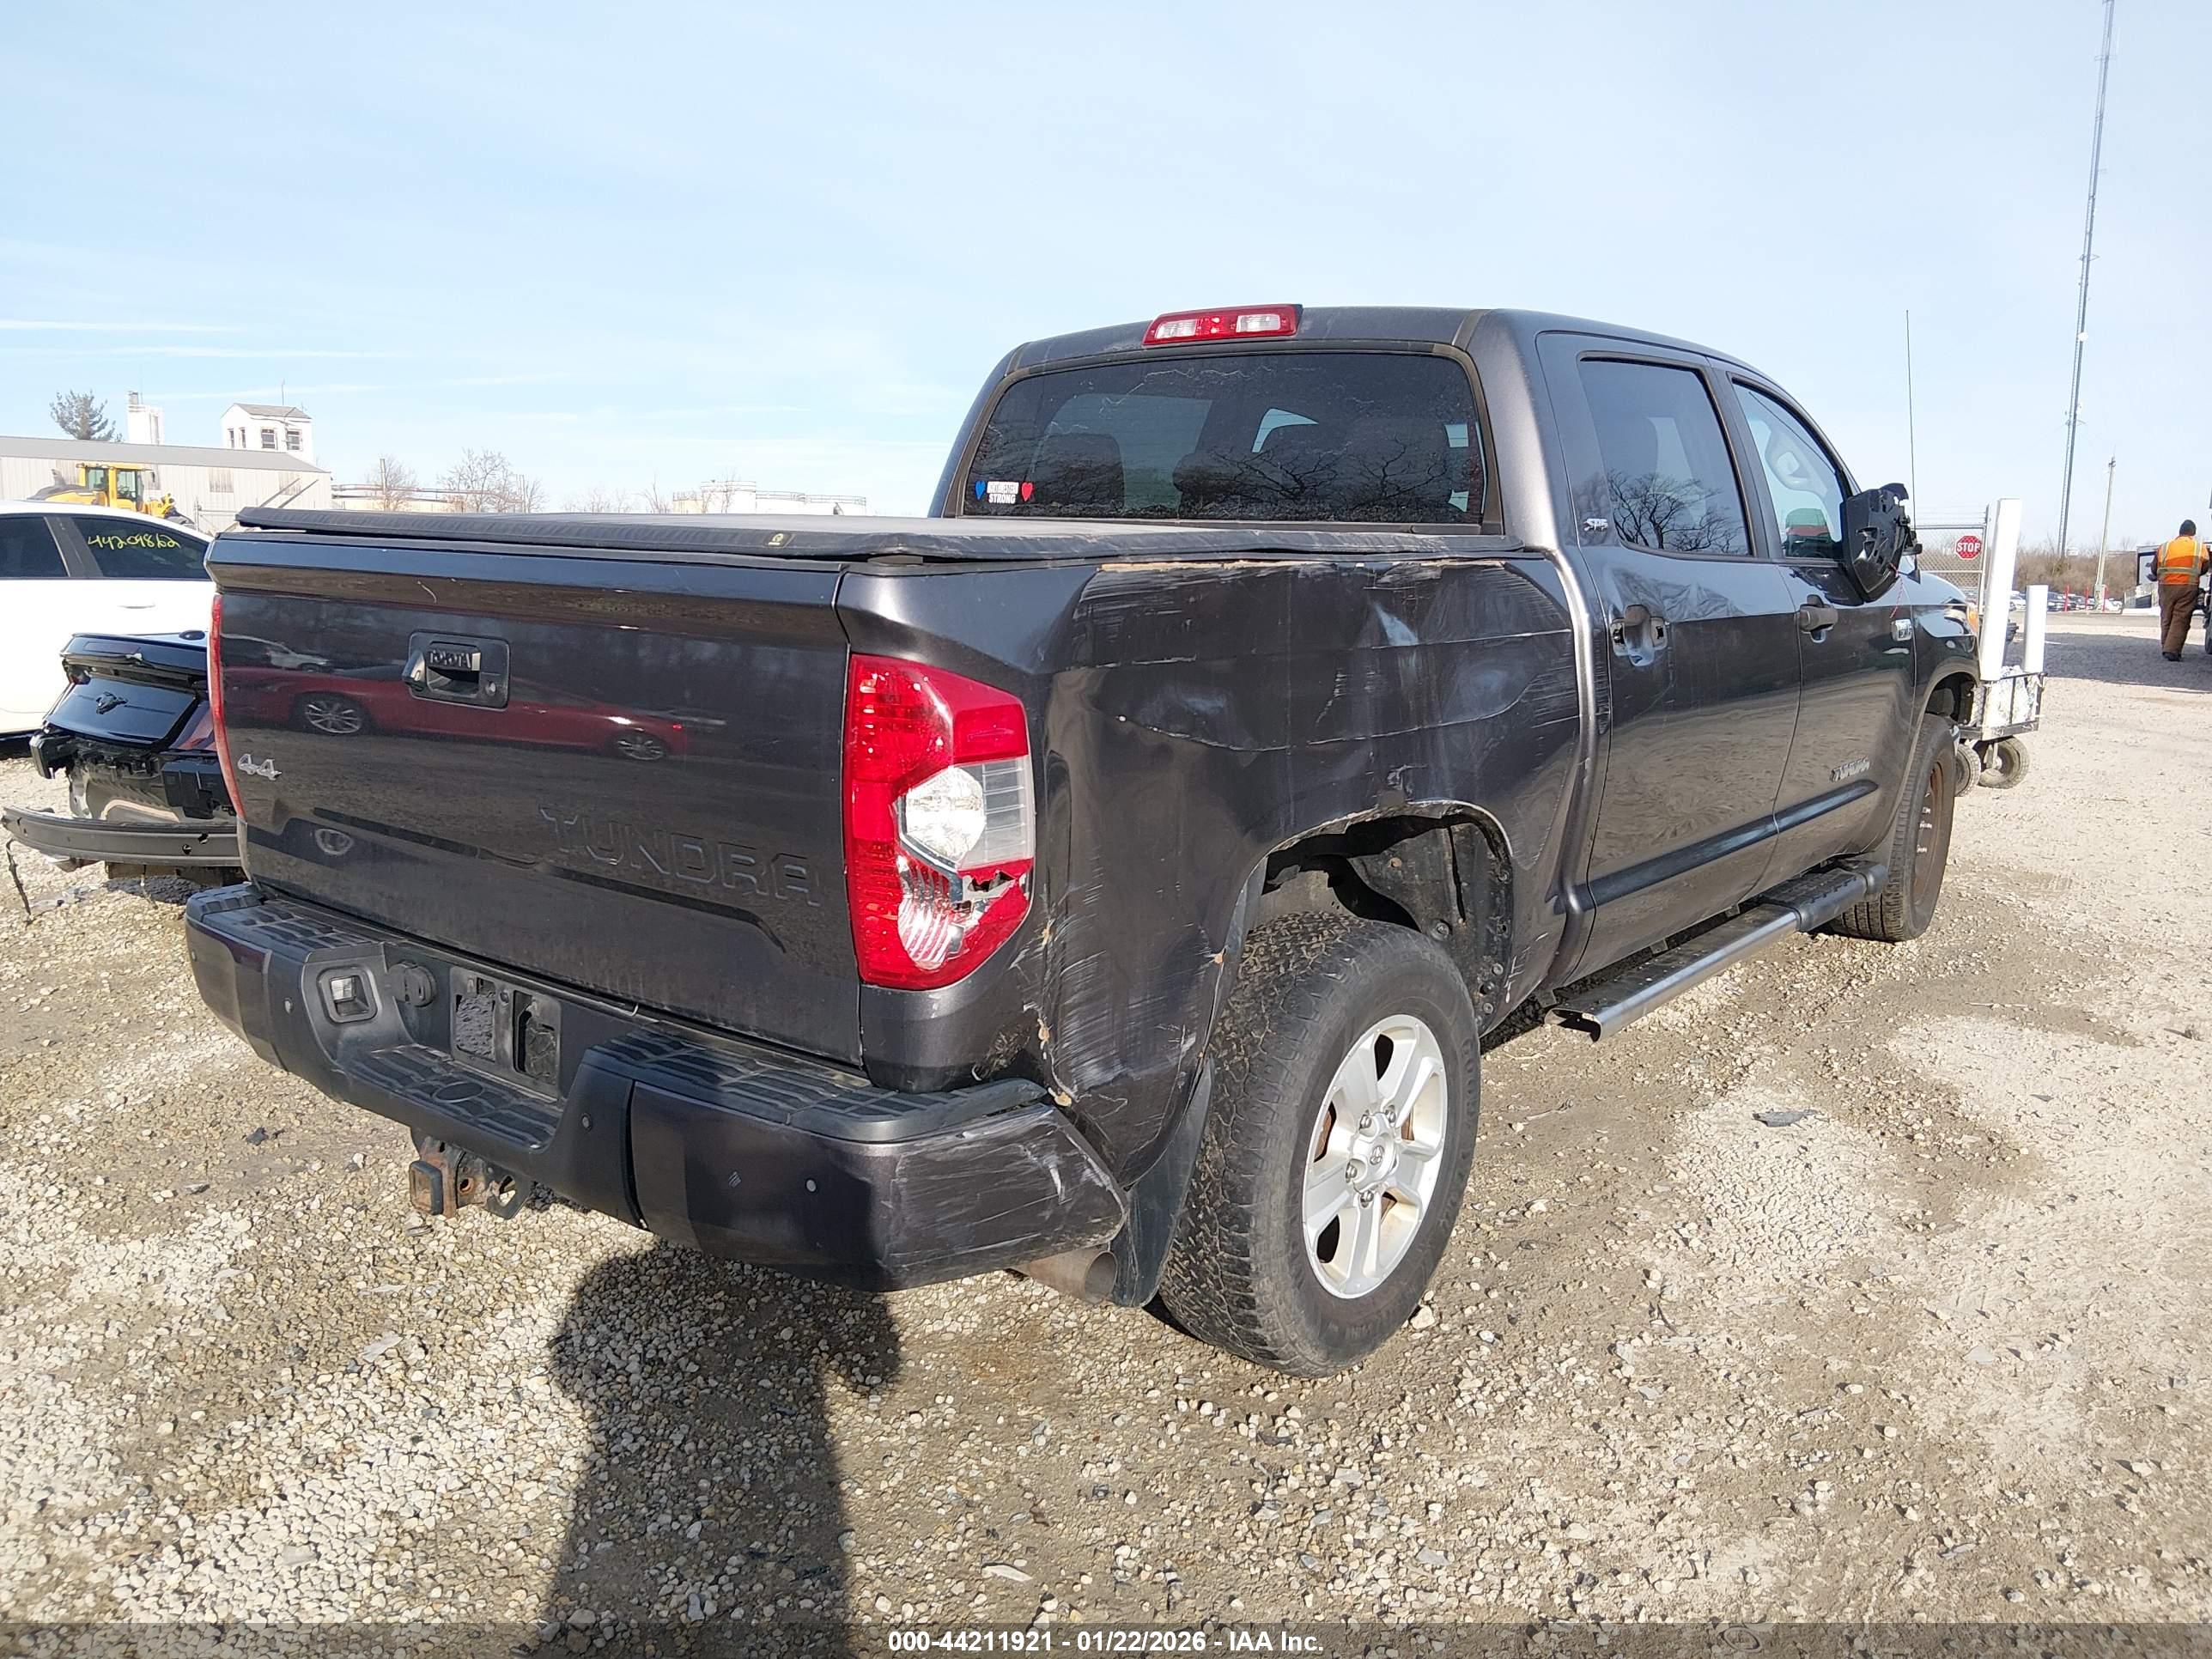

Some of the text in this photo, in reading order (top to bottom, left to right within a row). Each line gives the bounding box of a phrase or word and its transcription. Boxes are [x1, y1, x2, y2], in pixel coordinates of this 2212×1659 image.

[988, 493, 1016, 504] STRONG
[88, 532, 181, 550] 44209862
[1956, 542, 1981, 552] STOP
[428, 649, 472, 669] TOYOTA
[538, 802, 822, 907] TUNDRA
